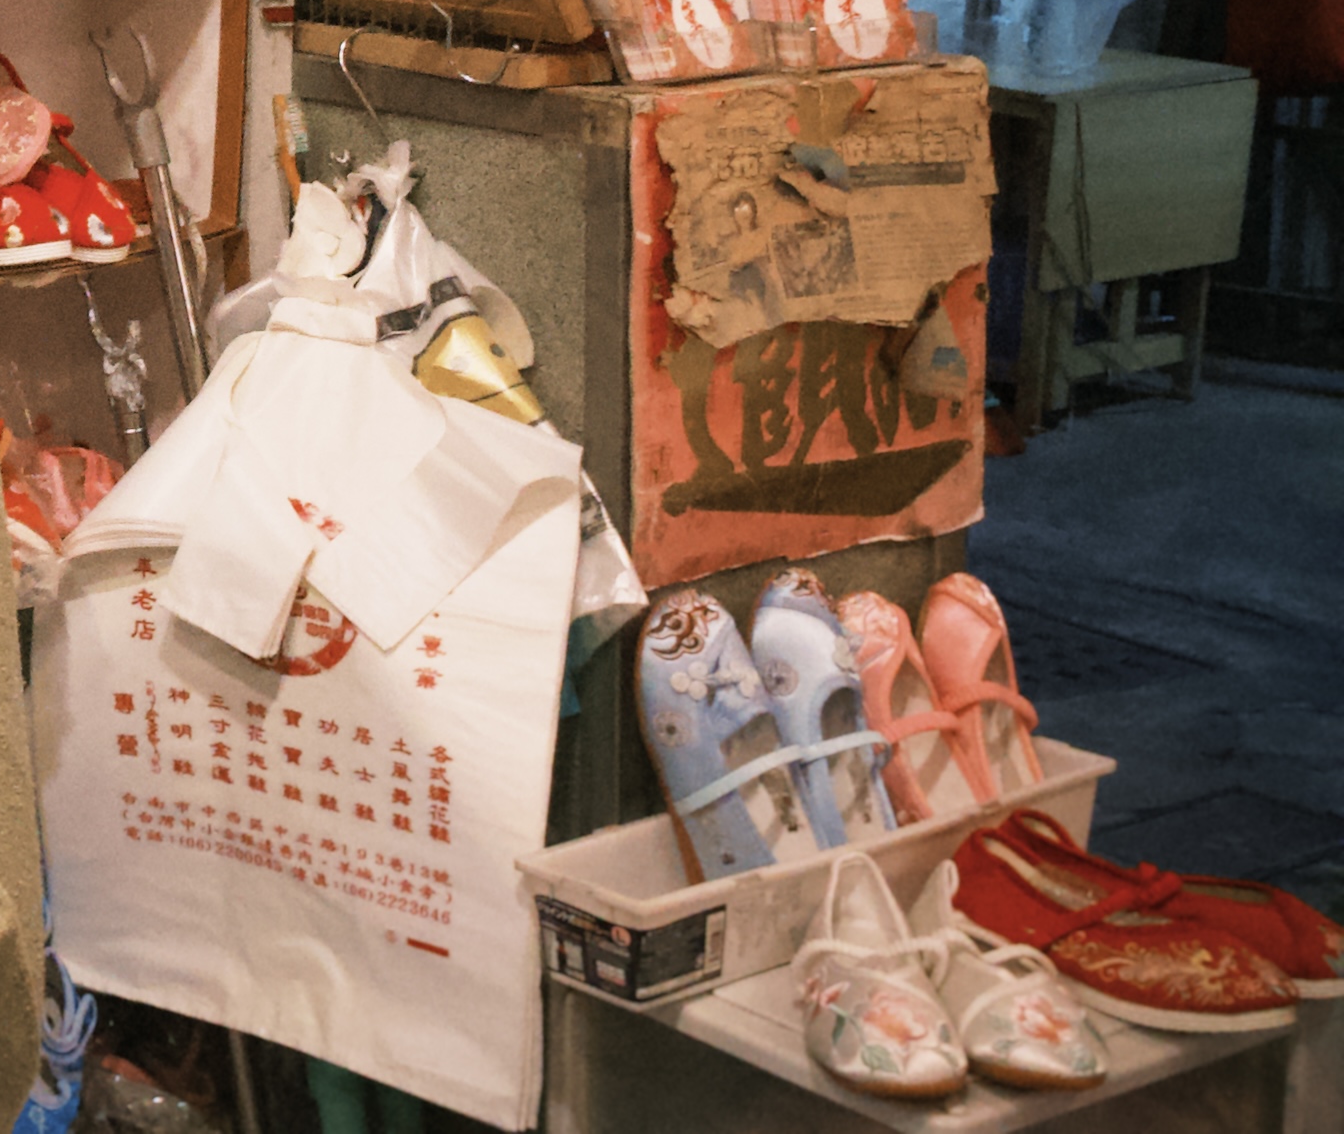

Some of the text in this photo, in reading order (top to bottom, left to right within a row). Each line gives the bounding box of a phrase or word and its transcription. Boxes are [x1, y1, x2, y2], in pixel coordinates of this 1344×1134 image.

[168, 687, 195, 776] 神明鞋
[208, 693, 234, 785] 三寸金蓮
[318, 719, 341, 813] 功夫鞋
[352, 726, 376, 823] 居士鞋
[390, 737, 413, 833] 土風舞鞋
[427, 745, 453, 844] 各式繡花鞋
